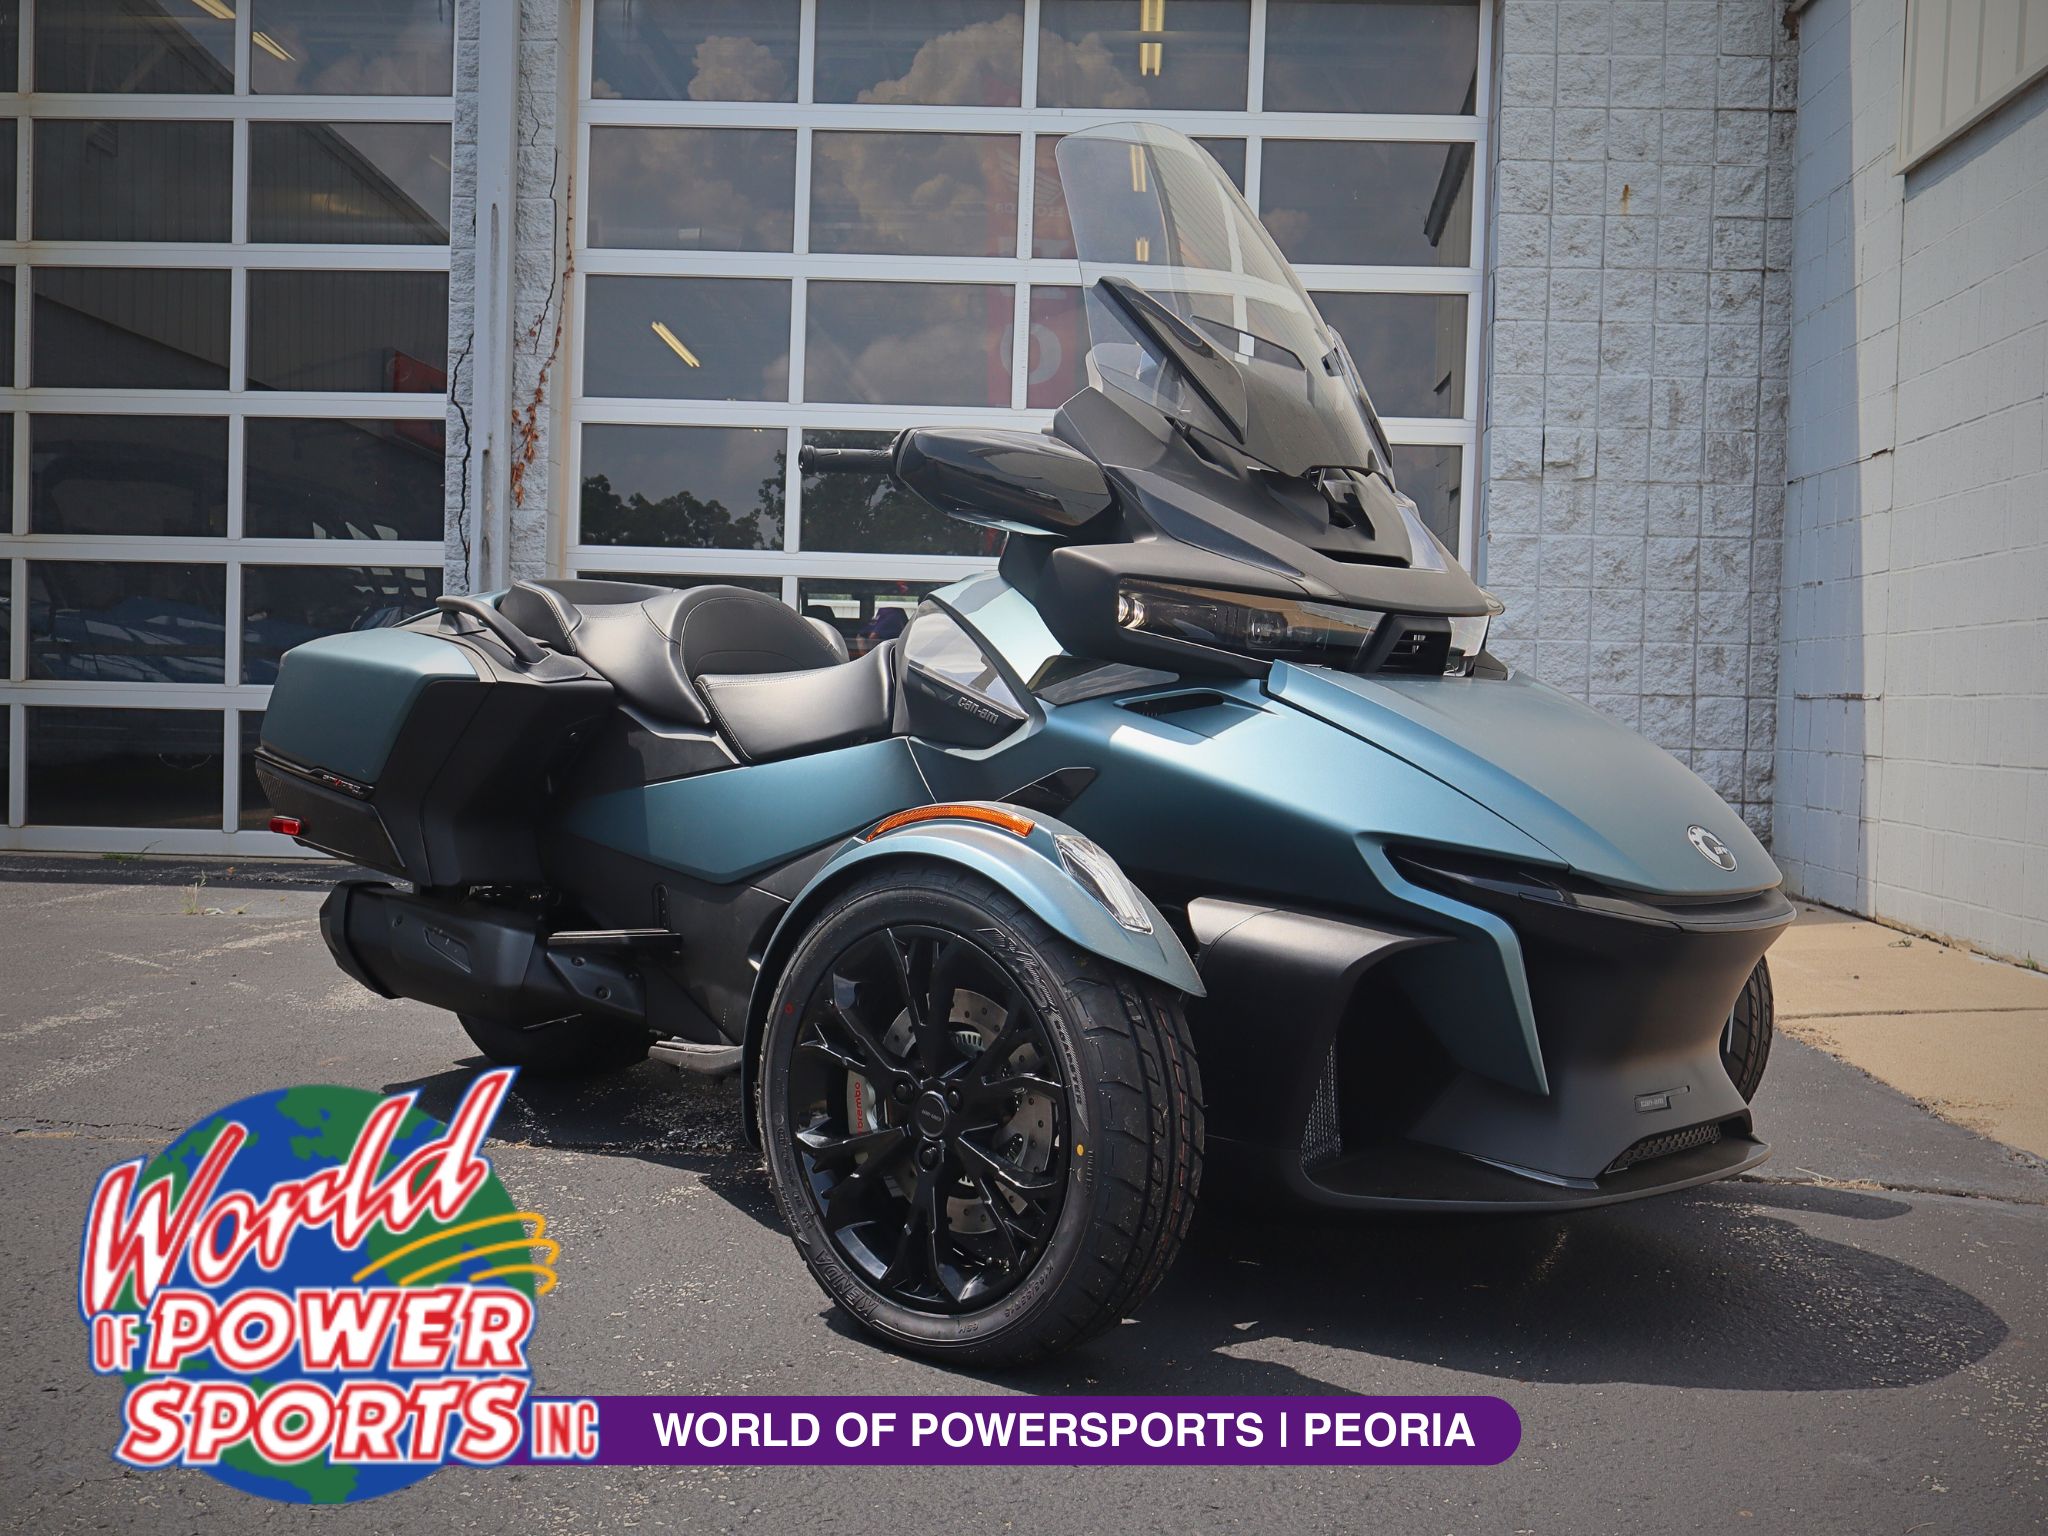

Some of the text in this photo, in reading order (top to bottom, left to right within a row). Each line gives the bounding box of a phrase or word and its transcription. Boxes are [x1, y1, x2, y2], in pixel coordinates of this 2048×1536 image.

[958, 697, 999, 724] can-am
[854, 1080, 863, 1129] brembo
[815, 1248, 879, 1317] KENDA
